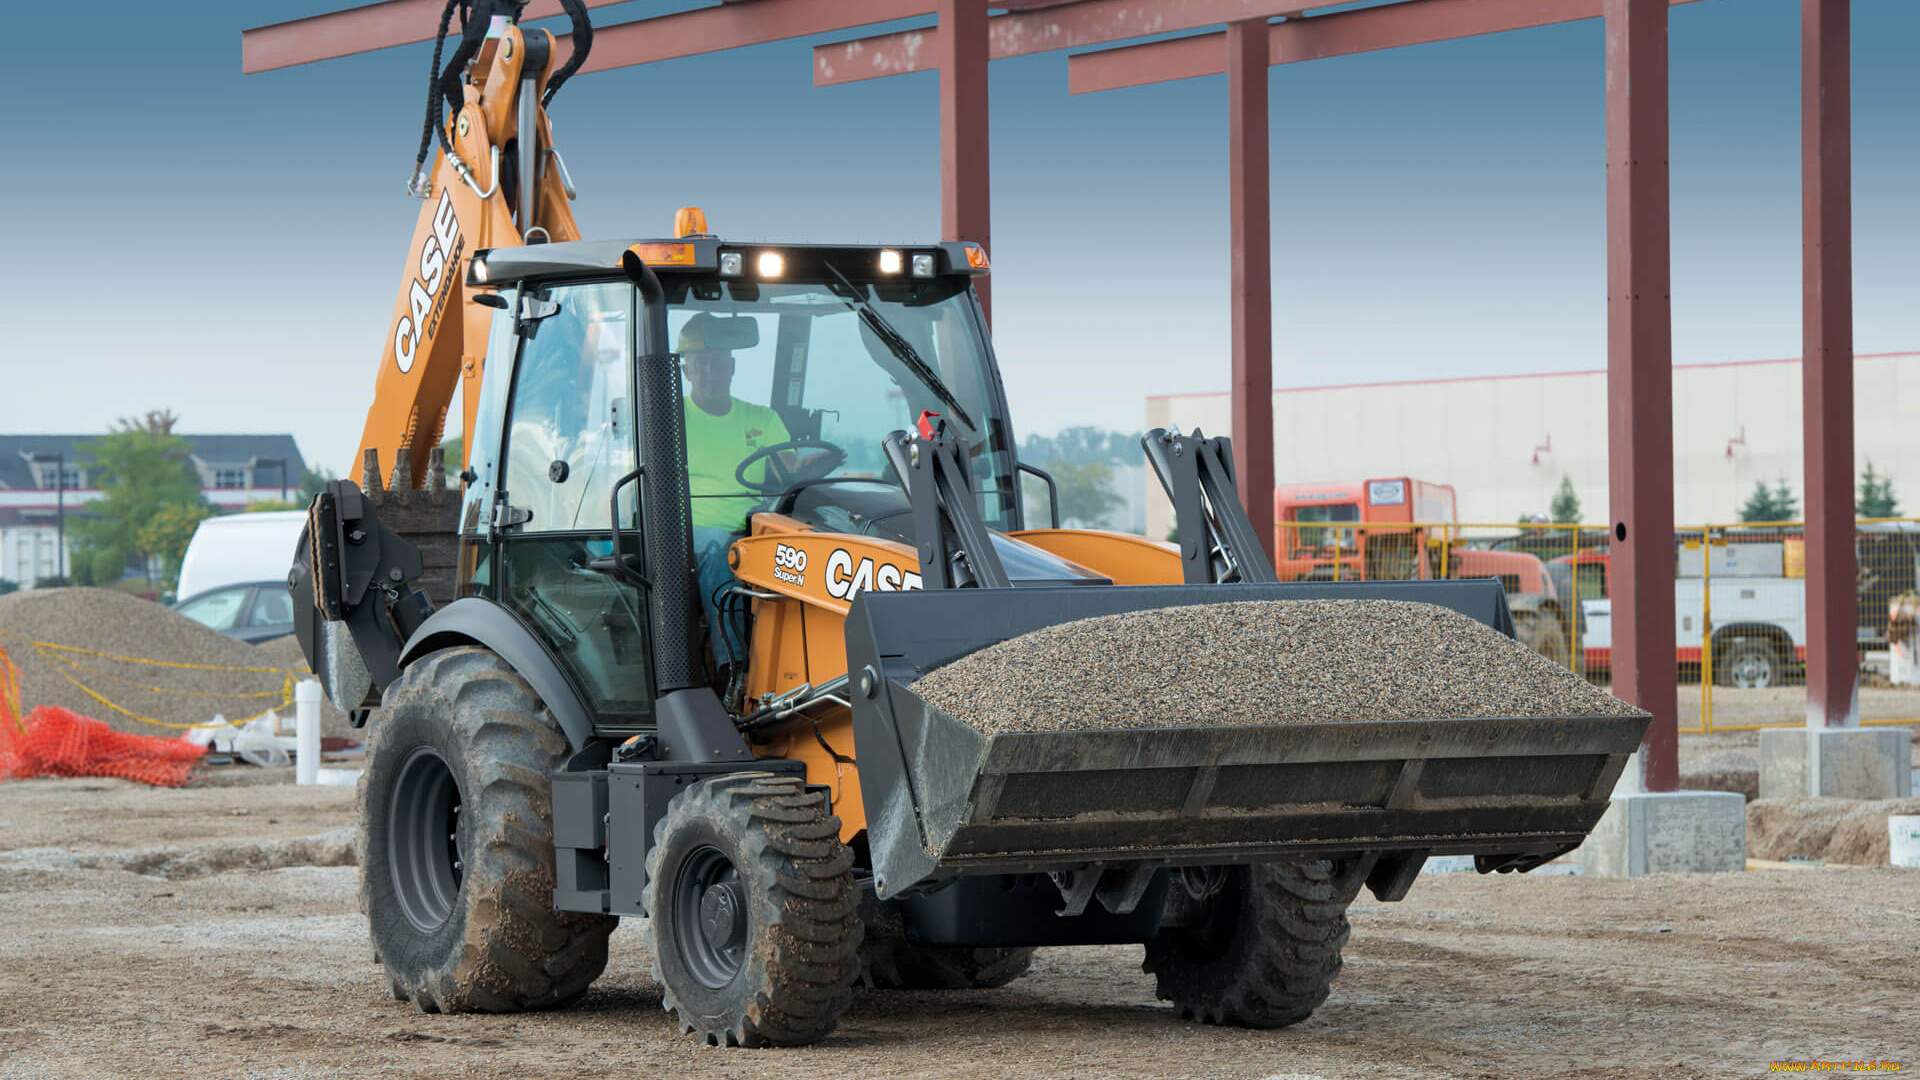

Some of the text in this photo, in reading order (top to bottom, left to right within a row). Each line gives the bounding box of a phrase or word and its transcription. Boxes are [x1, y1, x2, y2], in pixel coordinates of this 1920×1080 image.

[394, 186, 459, 374] CASE
[428, 234, 465, 340] EXTENDAHOE
[774, 566, 804, 587] Super N
[775, 543, 807, 573] 590
